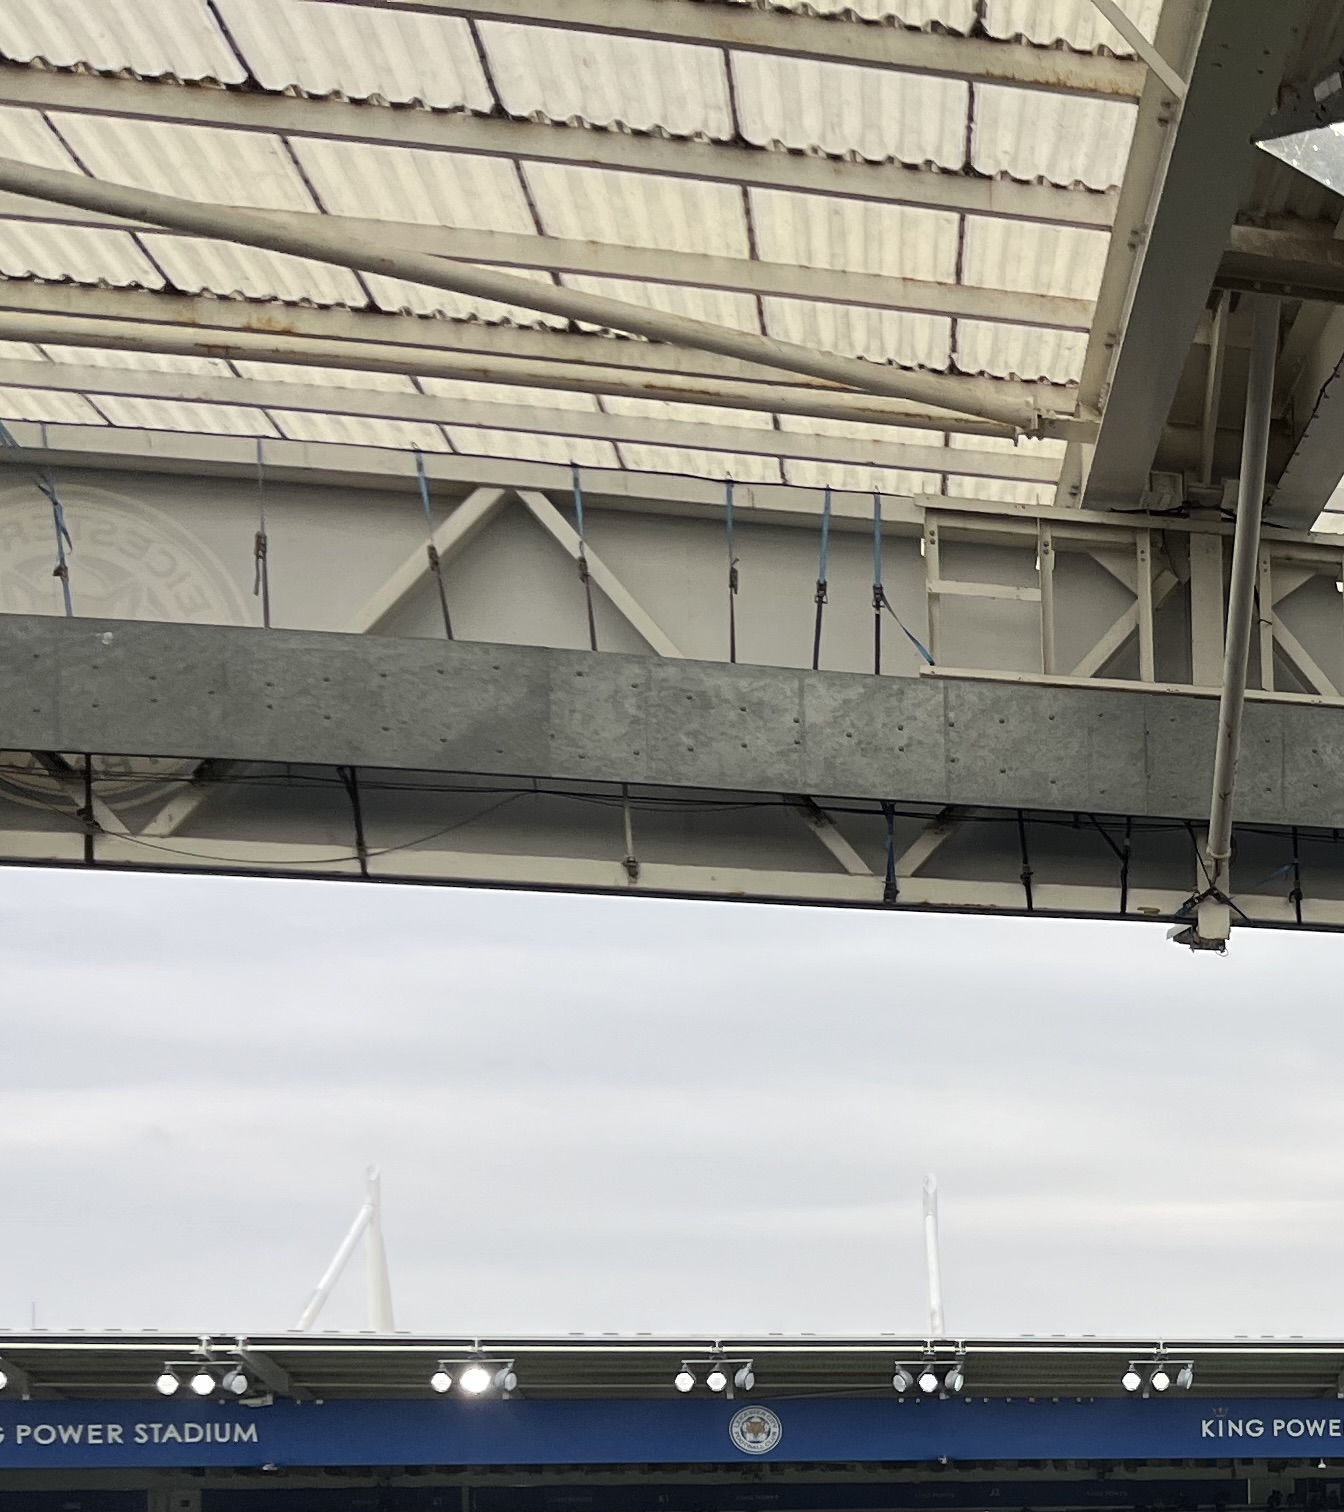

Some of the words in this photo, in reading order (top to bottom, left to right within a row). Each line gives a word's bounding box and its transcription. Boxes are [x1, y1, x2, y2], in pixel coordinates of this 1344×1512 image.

[16, 1424, 124, 1444] POWER
[134, 1423, 258, 1443] STADIUM
[1201, 1418, 1264, 1438] KING
